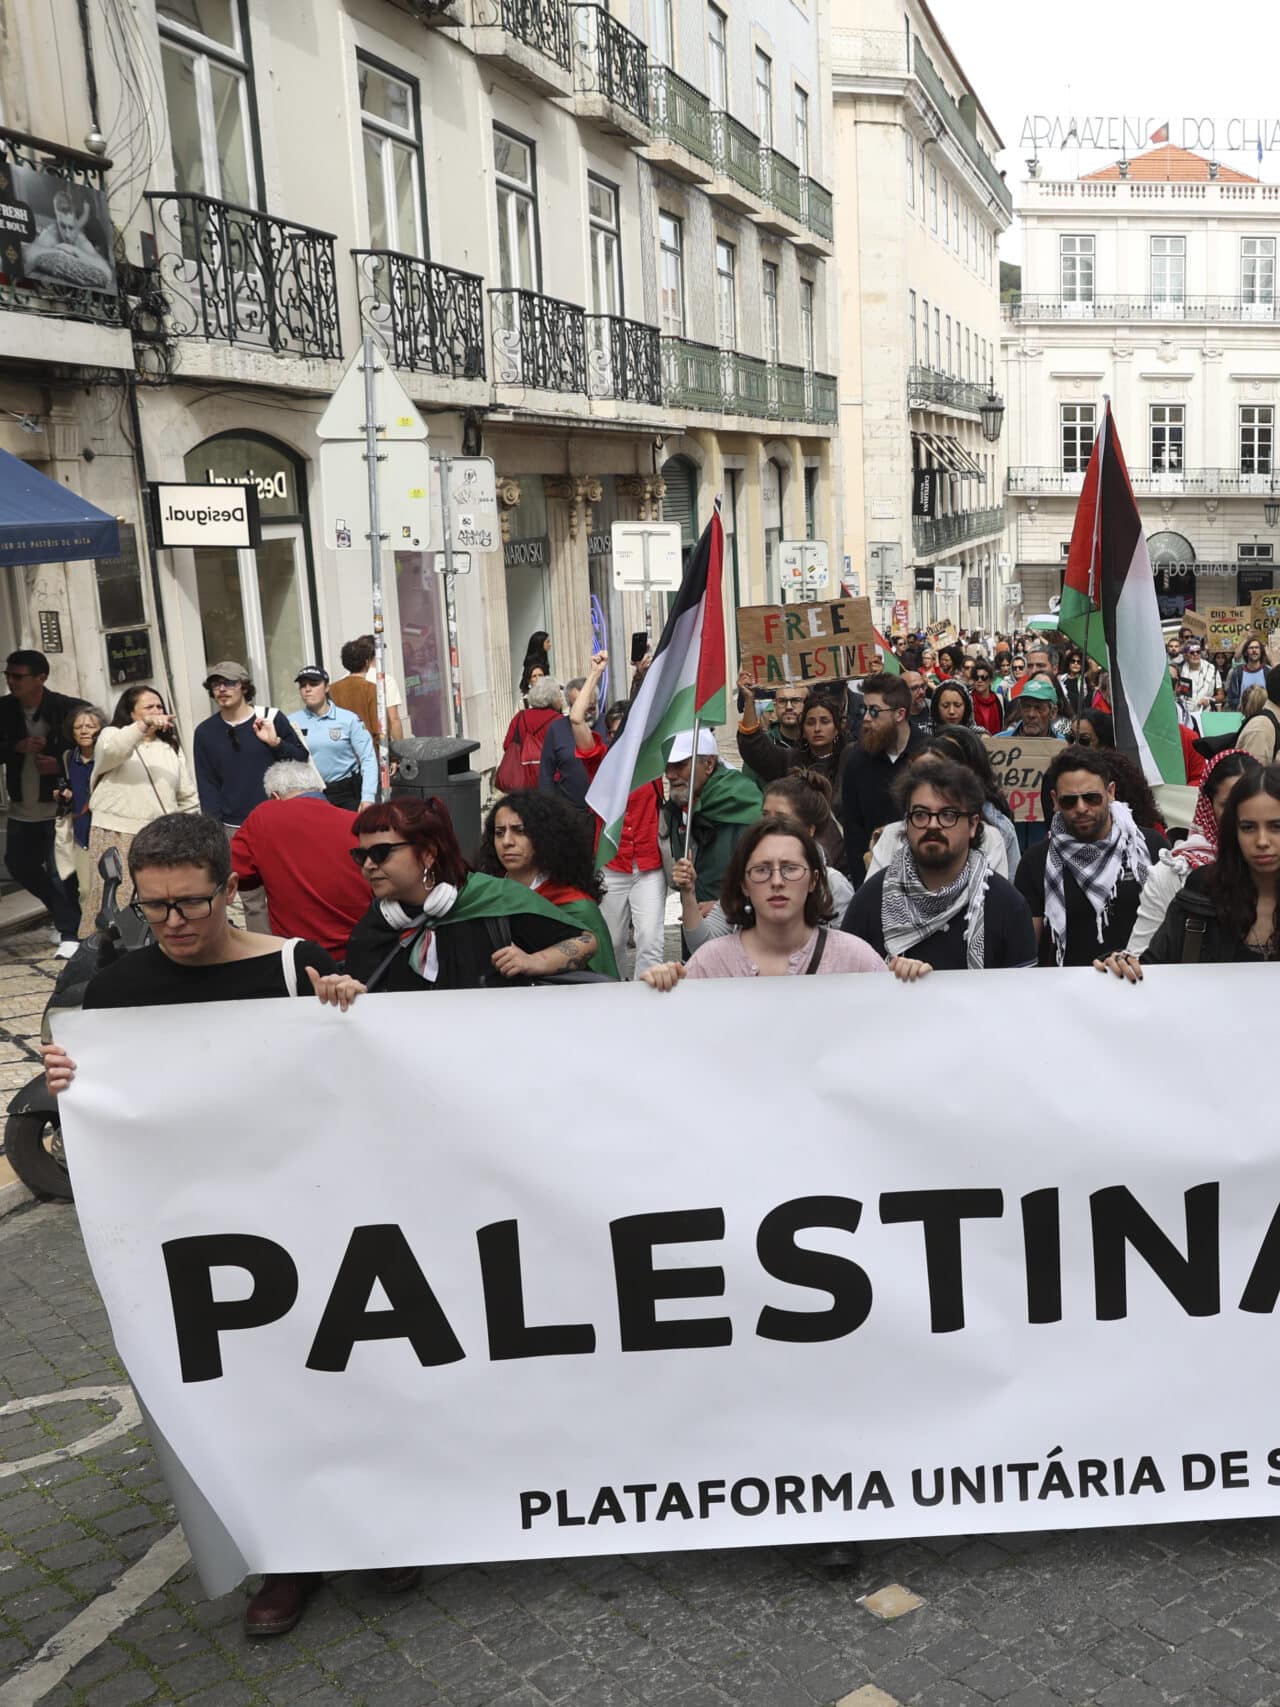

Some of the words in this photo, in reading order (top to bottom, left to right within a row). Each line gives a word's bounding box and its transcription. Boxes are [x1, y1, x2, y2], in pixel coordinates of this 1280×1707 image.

[1183, 117, 1214, 151] DO
[1168, 561, 1188, 576] DO
[763, 604, 850, 644] FREE
[752, 643, 870, 687] PALESTINE
[520, 1473, 895, 1530] PLATAFORMA
[912, 1446, 1166, 1507] UNITÁRIA
[1182, 1451, 1250, 1491] DE
